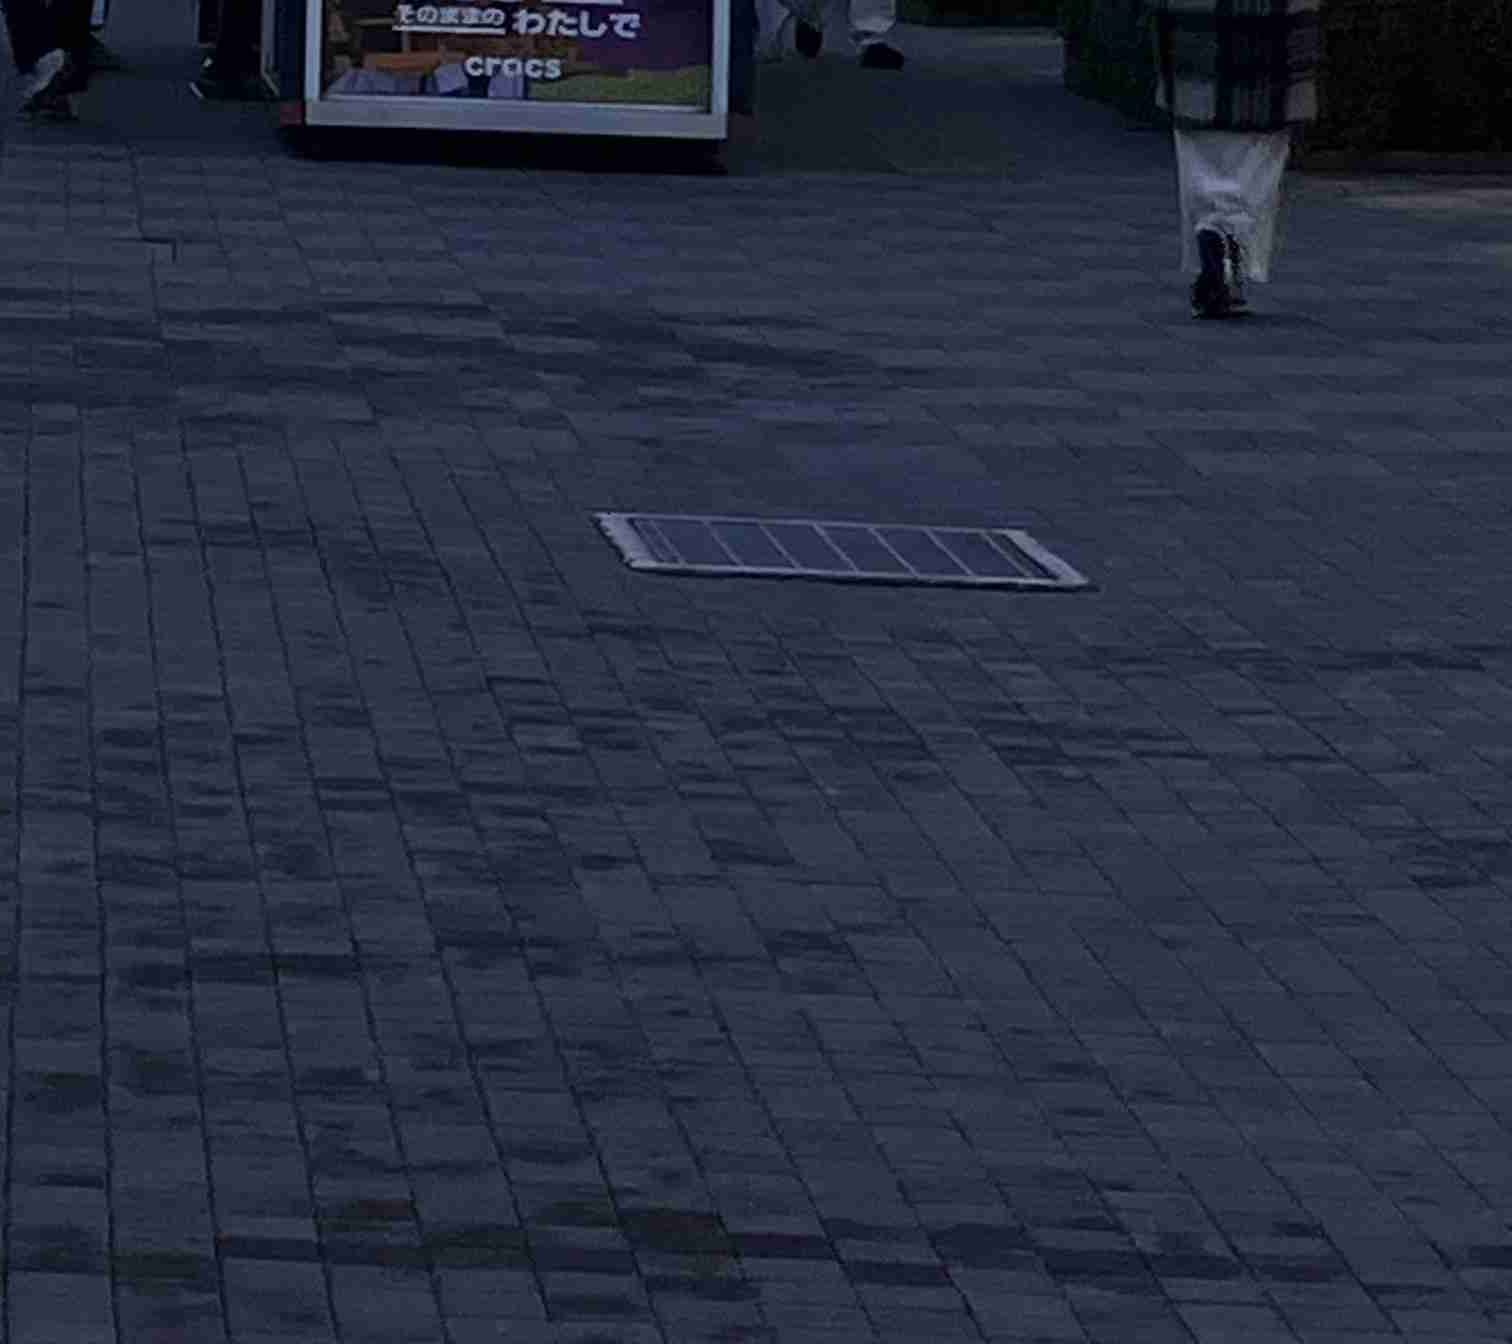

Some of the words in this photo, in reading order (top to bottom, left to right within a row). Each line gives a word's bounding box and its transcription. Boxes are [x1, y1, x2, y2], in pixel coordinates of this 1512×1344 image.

[511, 9, 641, 39] わたしで
[464, 56, 563, 80] crocs
